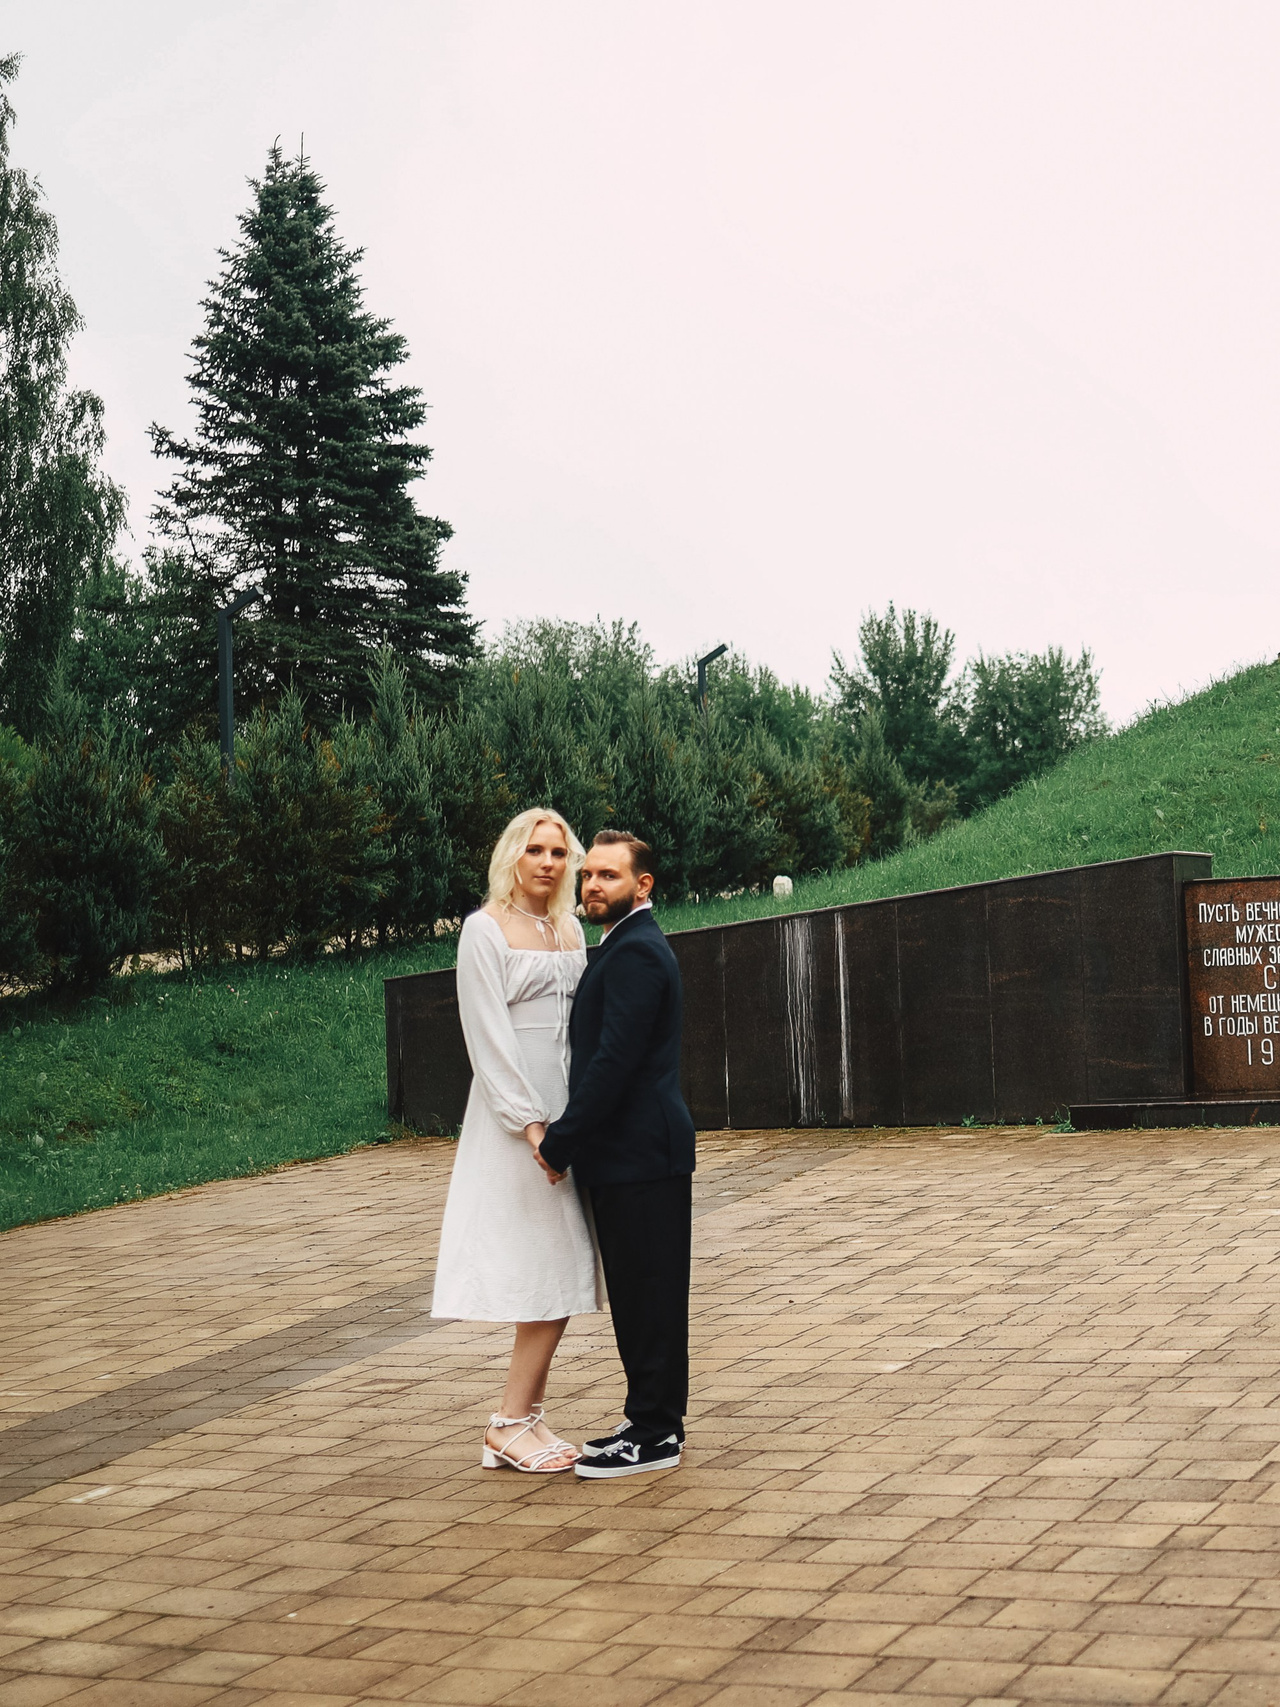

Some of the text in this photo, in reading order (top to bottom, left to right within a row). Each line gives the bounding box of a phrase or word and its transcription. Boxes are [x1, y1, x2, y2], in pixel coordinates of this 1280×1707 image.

[1199, 902, 1239, 923] ПУСТЬ
[1203, 946, 1262, 966] СЛАВНЫХ
[1208, 996, 1224, 1013] ОТ
[1204, 1017, 1212, 1036] В
[1219, 1016, 1258, 1035] ГОДЫ
